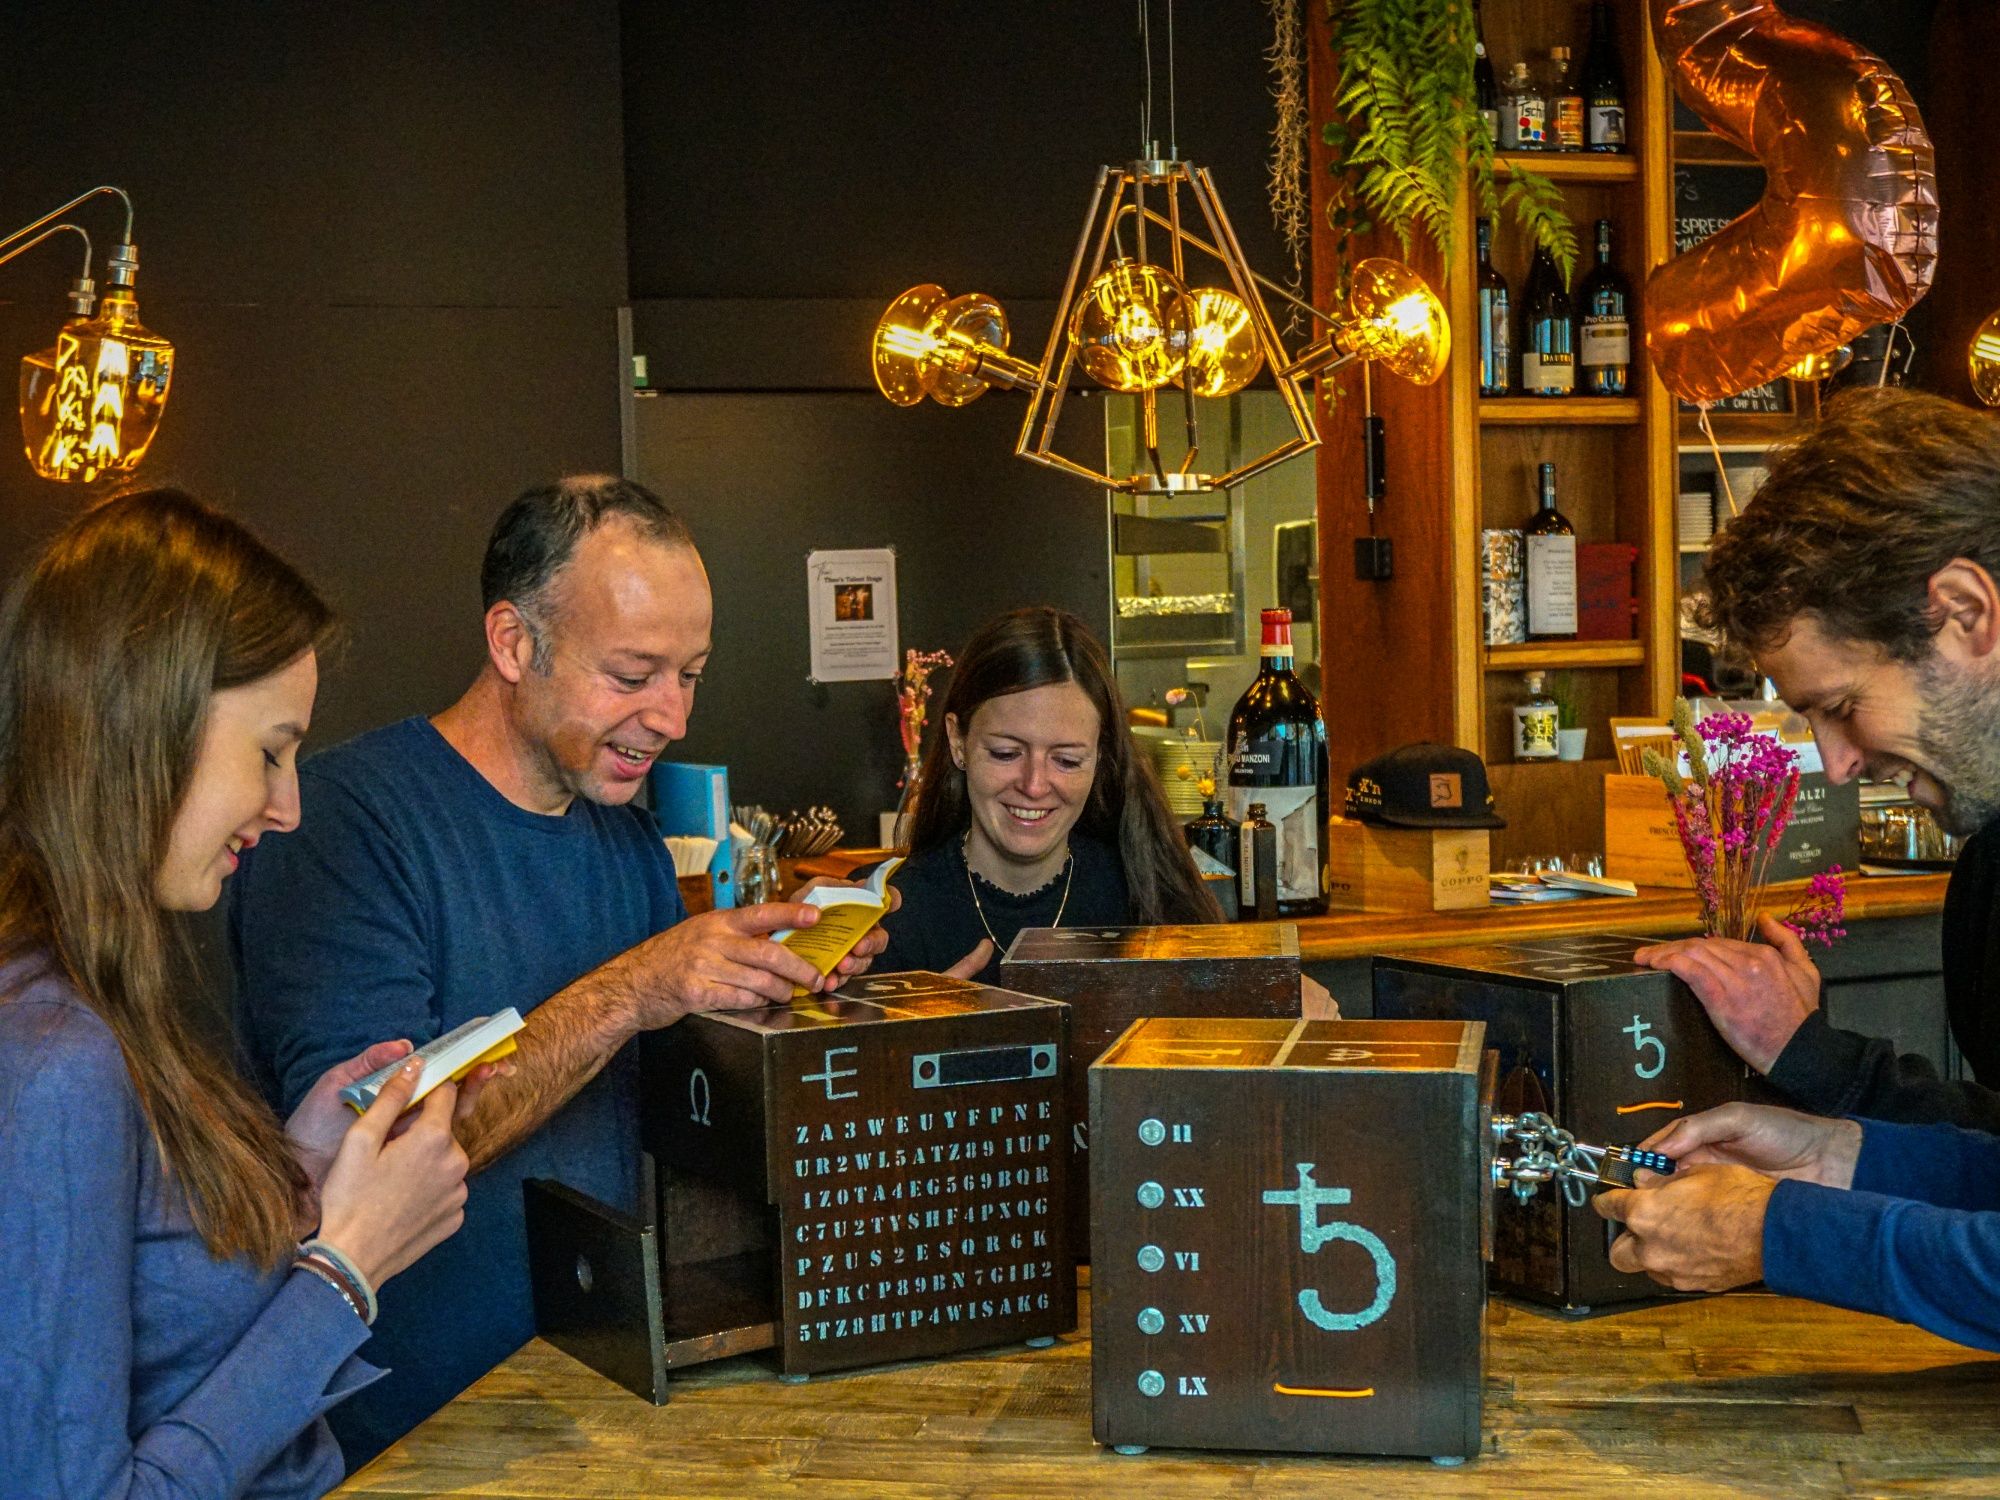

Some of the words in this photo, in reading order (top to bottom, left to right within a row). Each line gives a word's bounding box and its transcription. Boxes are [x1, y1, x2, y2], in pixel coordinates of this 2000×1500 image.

[1172, 1124, 1192, 1143] II
[1173, 1187, 1205, 1208] XX
[1174, 1251, 1200, 1271] VI
[1179, 1314, 1210, 1333] XV
[1178, 1376, 1209, 1396] LX
